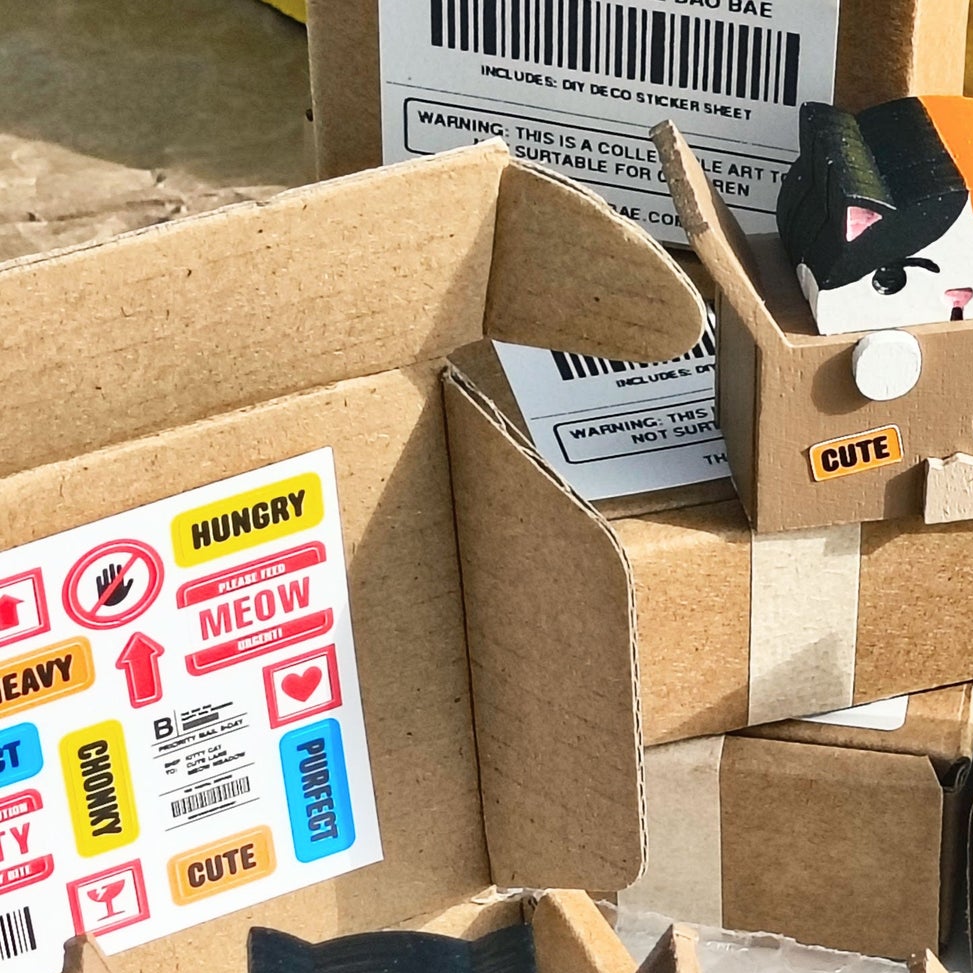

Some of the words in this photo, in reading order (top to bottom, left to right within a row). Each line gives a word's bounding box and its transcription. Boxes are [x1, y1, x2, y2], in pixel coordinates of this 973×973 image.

[728, 0, 773, 17] BAE
[481, 65, 557, 88] INCLUDES:
[562, 79, 585, 92] DIY
[590, 84, 632, 101] DECO
[636, 92, 700, 112] STICKER
[704, 103, 752, 120] SHEET
[417, 110, 509, 137] WARNING:
[515, 126, 554, 145] THIS
[559, 135, 577, 149] IS
[580, 139, 593, 152] A
[727, 163, 764, 180] ART
[615, 163, 651, 181] FOR
[615, 368, 692, 388] INCLUDES:
[569, 417, 664, 440] WARNING:
[666, 408, 709, 424] THIS
[631, 429, 668, 445] NOT
[820, 435, 891, 473] CUTE
[191, 488, 306, 550] HUNGRY
[218, 571, 257, 593] PLEASE
[260, 563, 286, 579] FEED
[199, 576, 310, 641] MEOW
[0, 654, 72, 701] EAVY
[153, 717, 173, 740] B
[77, 739, 122, 837] CHONKY
[296, 737, 339, 844] PURFECT
[187, 843, 257, 888] CUTE
